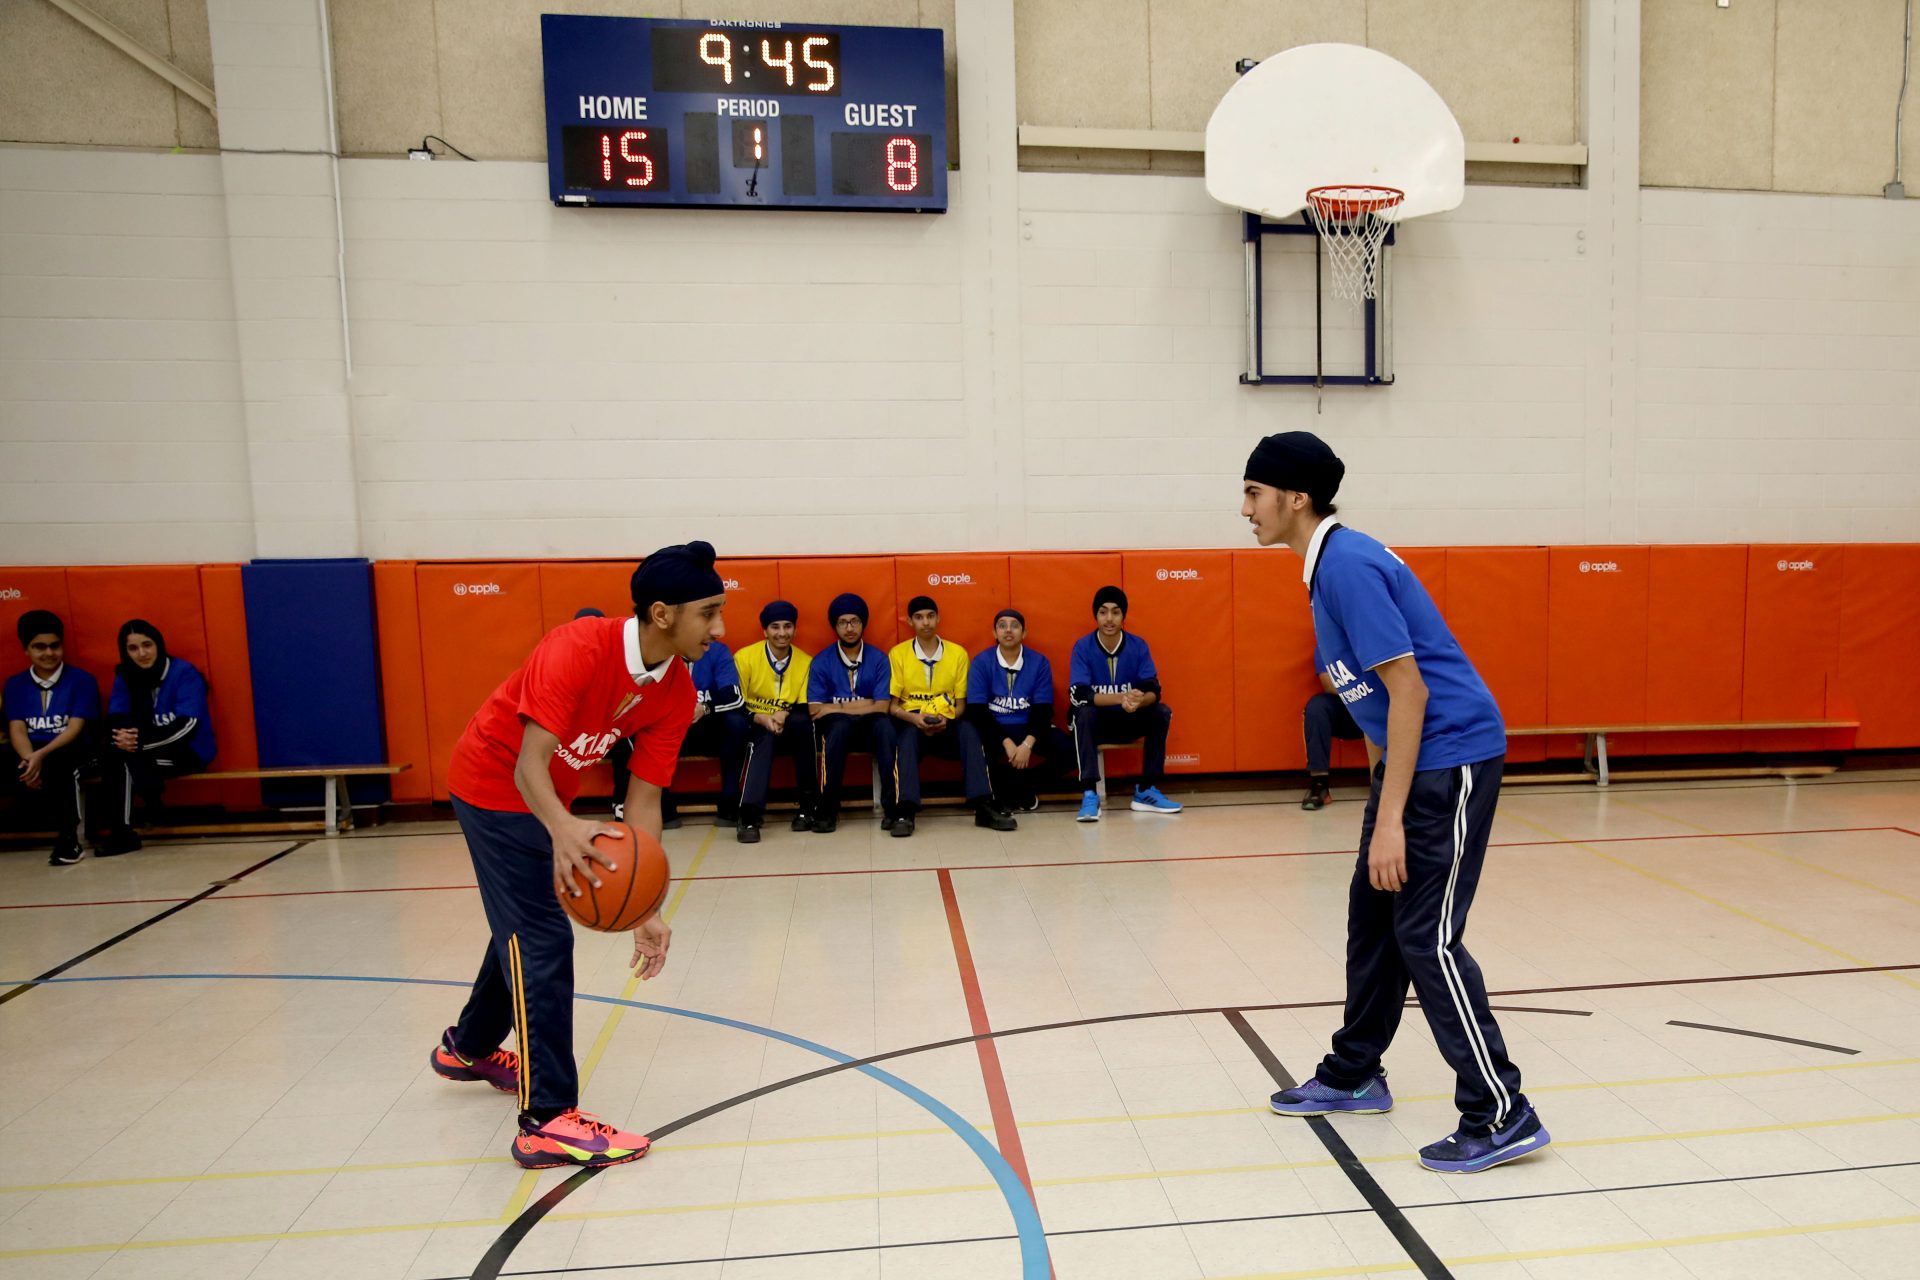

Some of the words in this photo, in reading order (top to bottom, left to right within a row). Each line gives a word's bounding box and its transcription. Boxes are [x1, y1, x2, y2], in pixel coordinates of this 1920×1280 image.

[710, 19, 782, 29] DAKTRONICS
[699, 33, 835, 92] 9:45
[579, 95, 648, 121] HOME
[717, 98, 780, 118] PERIOD
[844, 103, 917, 128] GUEST
[753, 127, 763, 160] 1
[601, 130, 653, 187] 15
[886, 137, 919, 192] 8
[1591, 561, 1617, 572] apple
[1788, 559, 1814, 570] apple
[941, 572, 971, 585] apple
[1169, 568, 1198, 580] apple
[0, 587, 21, 600] ple
[468, 582, 500, 595] apple
